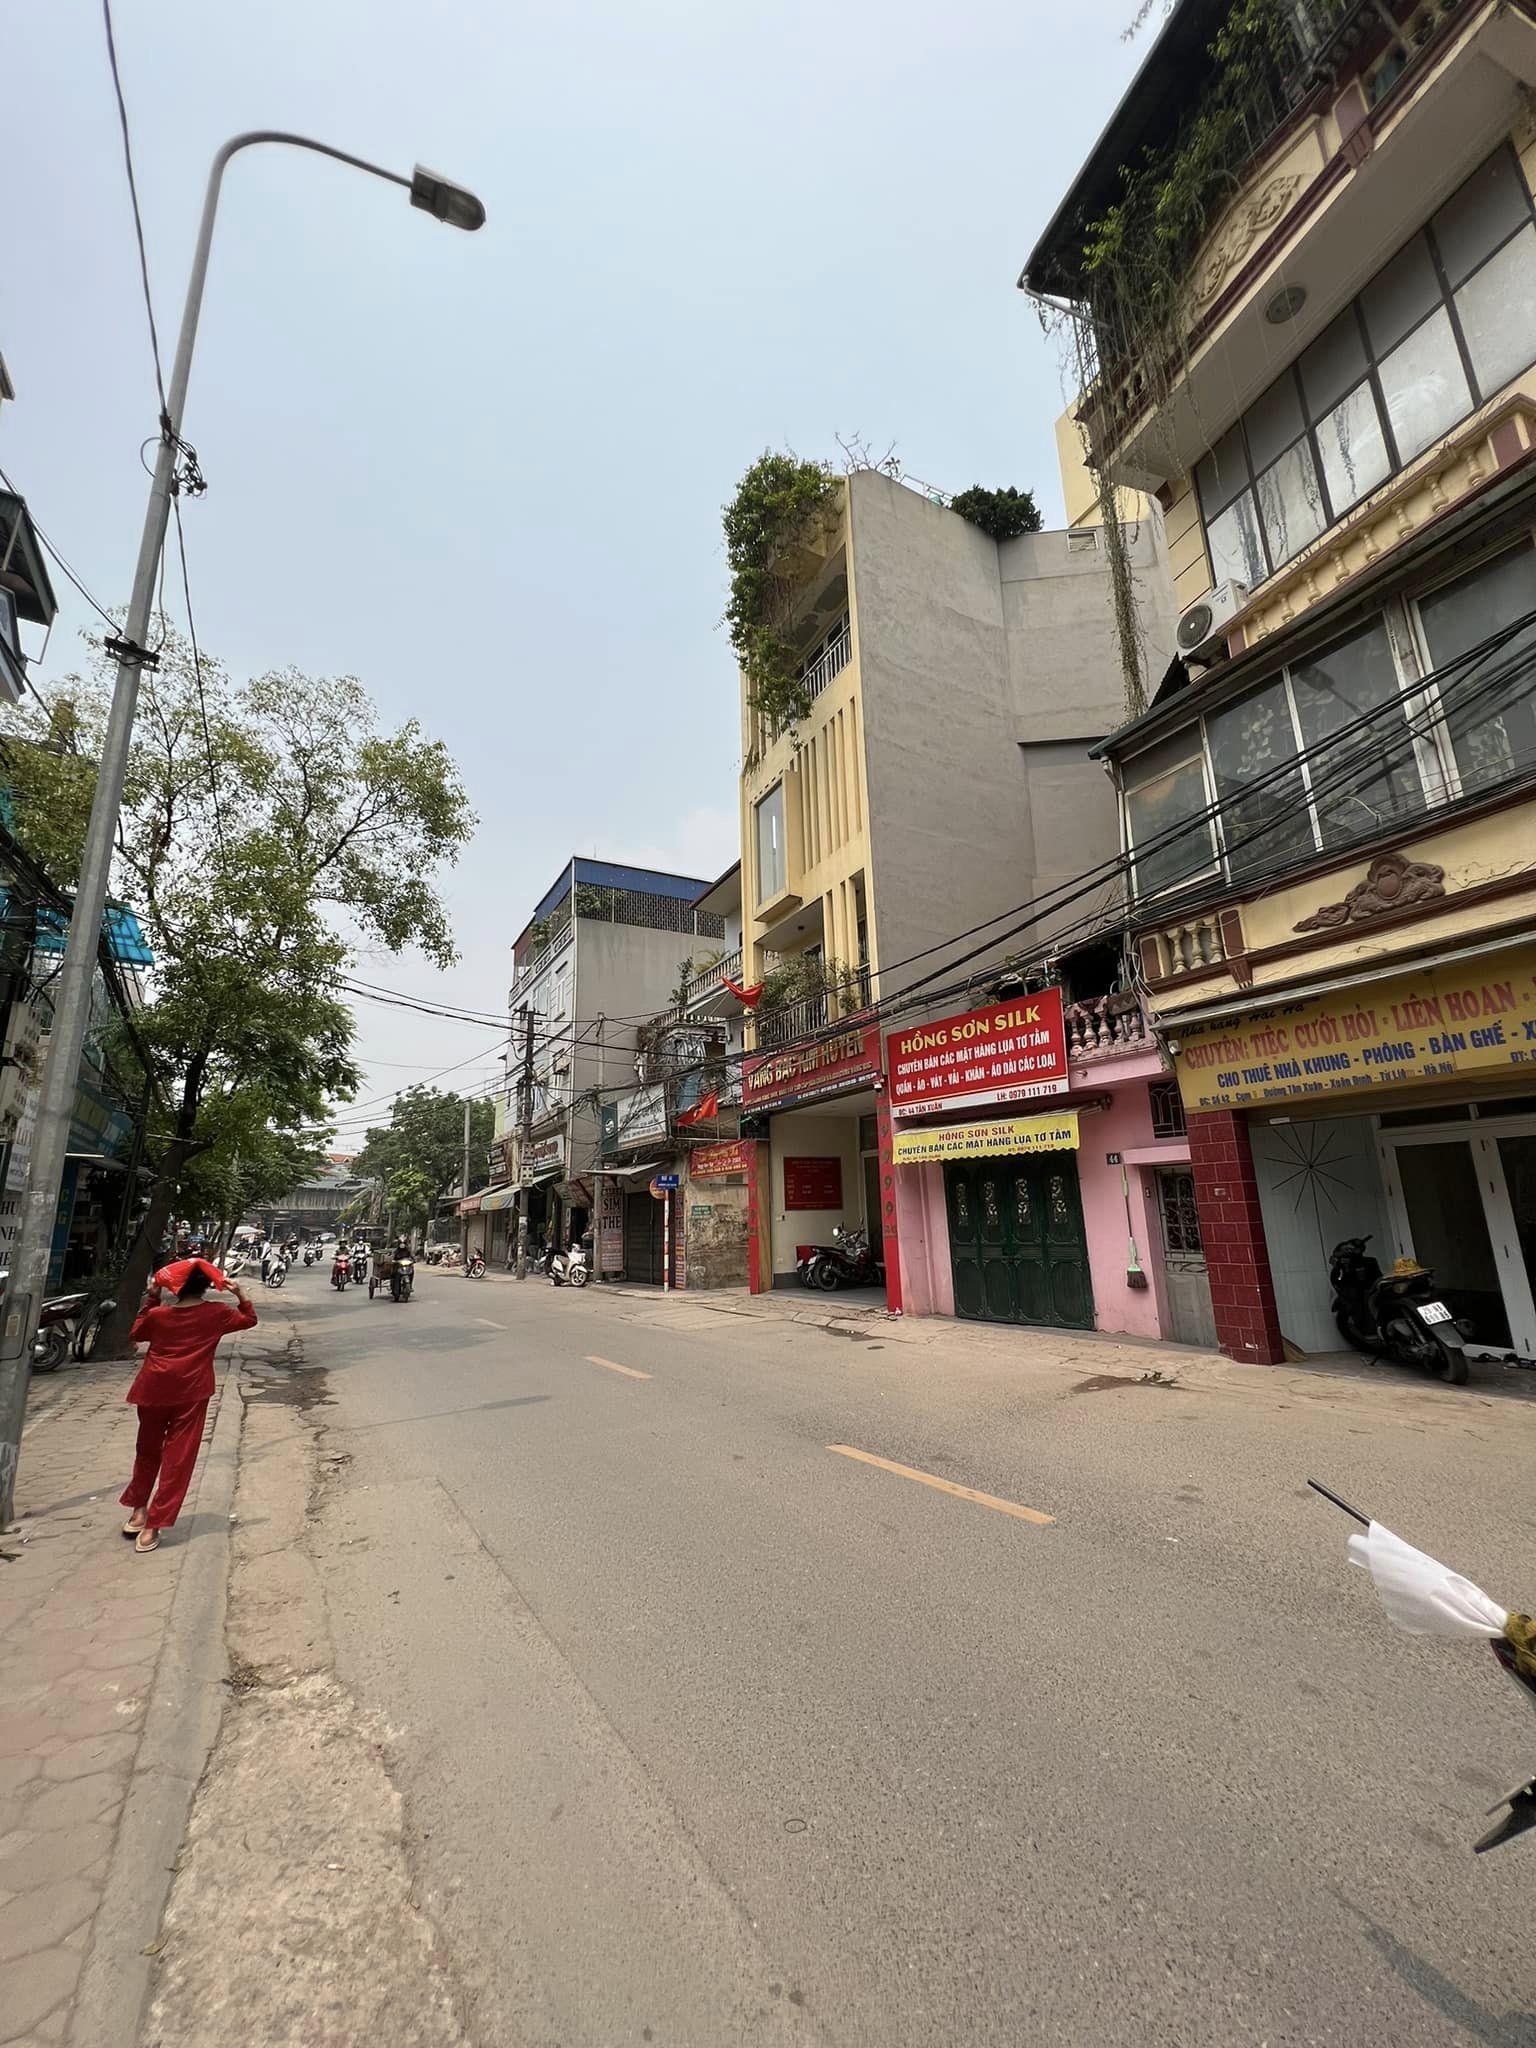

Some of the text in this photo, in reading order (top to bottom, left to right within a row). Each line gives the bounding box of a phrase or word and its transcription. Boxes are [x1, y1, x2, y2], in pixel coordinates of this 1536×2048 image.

[901, 1005, 1041, 1055] HỒNG SƠN SILK
[1250, 1024, 1289, 1060] TIỆC
[1294, 1012, 1341, 1049] CƯỚI
[1341, 1004, 1380, 1042] HỎI
[1391, 993, 1446, 1032] LIÊN
[1445, 982, 1517, 1021] HOAN
[897, 1060, 923, 1075] CHUYÊN
[924, 1056, 939, 1071] BÁN
[940, 1051, 955, 1066] CÁC
[956, 1046, 974, 1064] MẶT
[974, 1042, 997, 1059] HÀNG
[998, 1038, 1015, 1055] LỤA
[1016, 1035, 1028, 1050] TƠ
[991, 1062, 1001, 1077] ÁO
[1003, 1059, 1017, 1074] DÀI
[1018, 1057, 1035, 1073] CÁC
[1036, 1053, 1056, 1070] LOẠI
[1217, 1071, 1240, 1088] CHO
[1241, 1063, 1272, 1084] THUÊ
[1273, 1058, 1302, 1080] NHÀ
[1303, 1052, 1350, 1075] KHUNG
[1362, 1042, 1416, 1066] PHÔNG
[1429, 1032, 1467, 1055] BÀN
[1470, 1020, 1506, 1048] GHẾ
[1028, 1086, 1041, 1097] 111
[1043, 1084, 1057, 1094] 719
[992, 1125, 1015, 1136] SILK
[1109, 1155, 1118, 1164] 44
